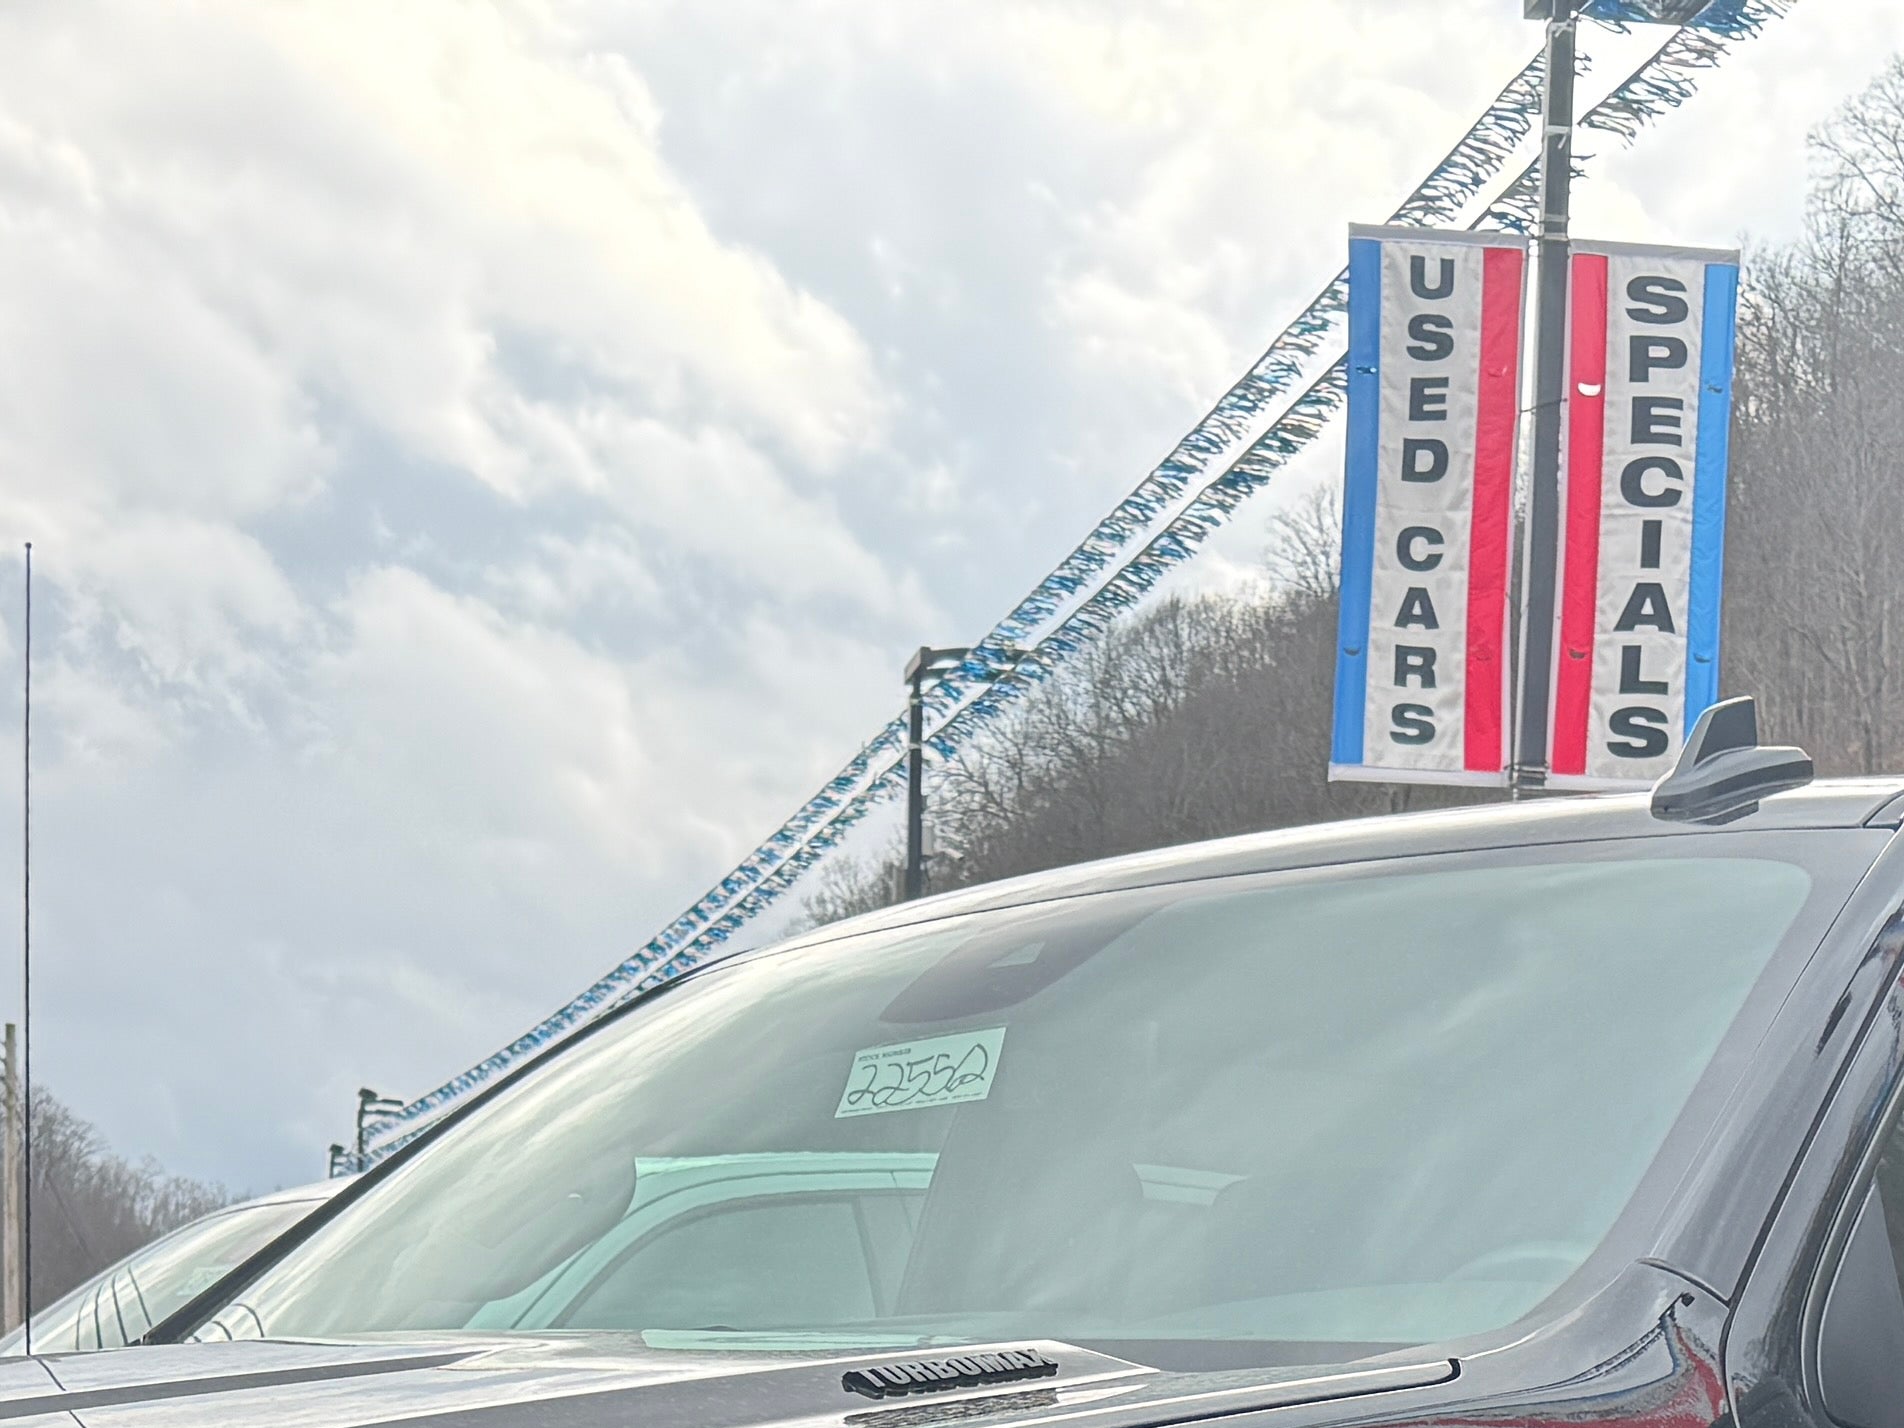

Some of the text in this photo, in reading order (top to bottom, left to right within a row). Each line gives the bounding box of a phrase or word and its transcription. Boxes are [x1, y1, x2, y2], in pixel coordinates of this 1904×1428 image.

[1388, 254, 1456, 746] USED CARS
[1605, 275, 1689, 759] SPECIALS
[846, 1043, 989, 1107] 22552
[841, 1347, 1059, 1399] TURBOMAX
